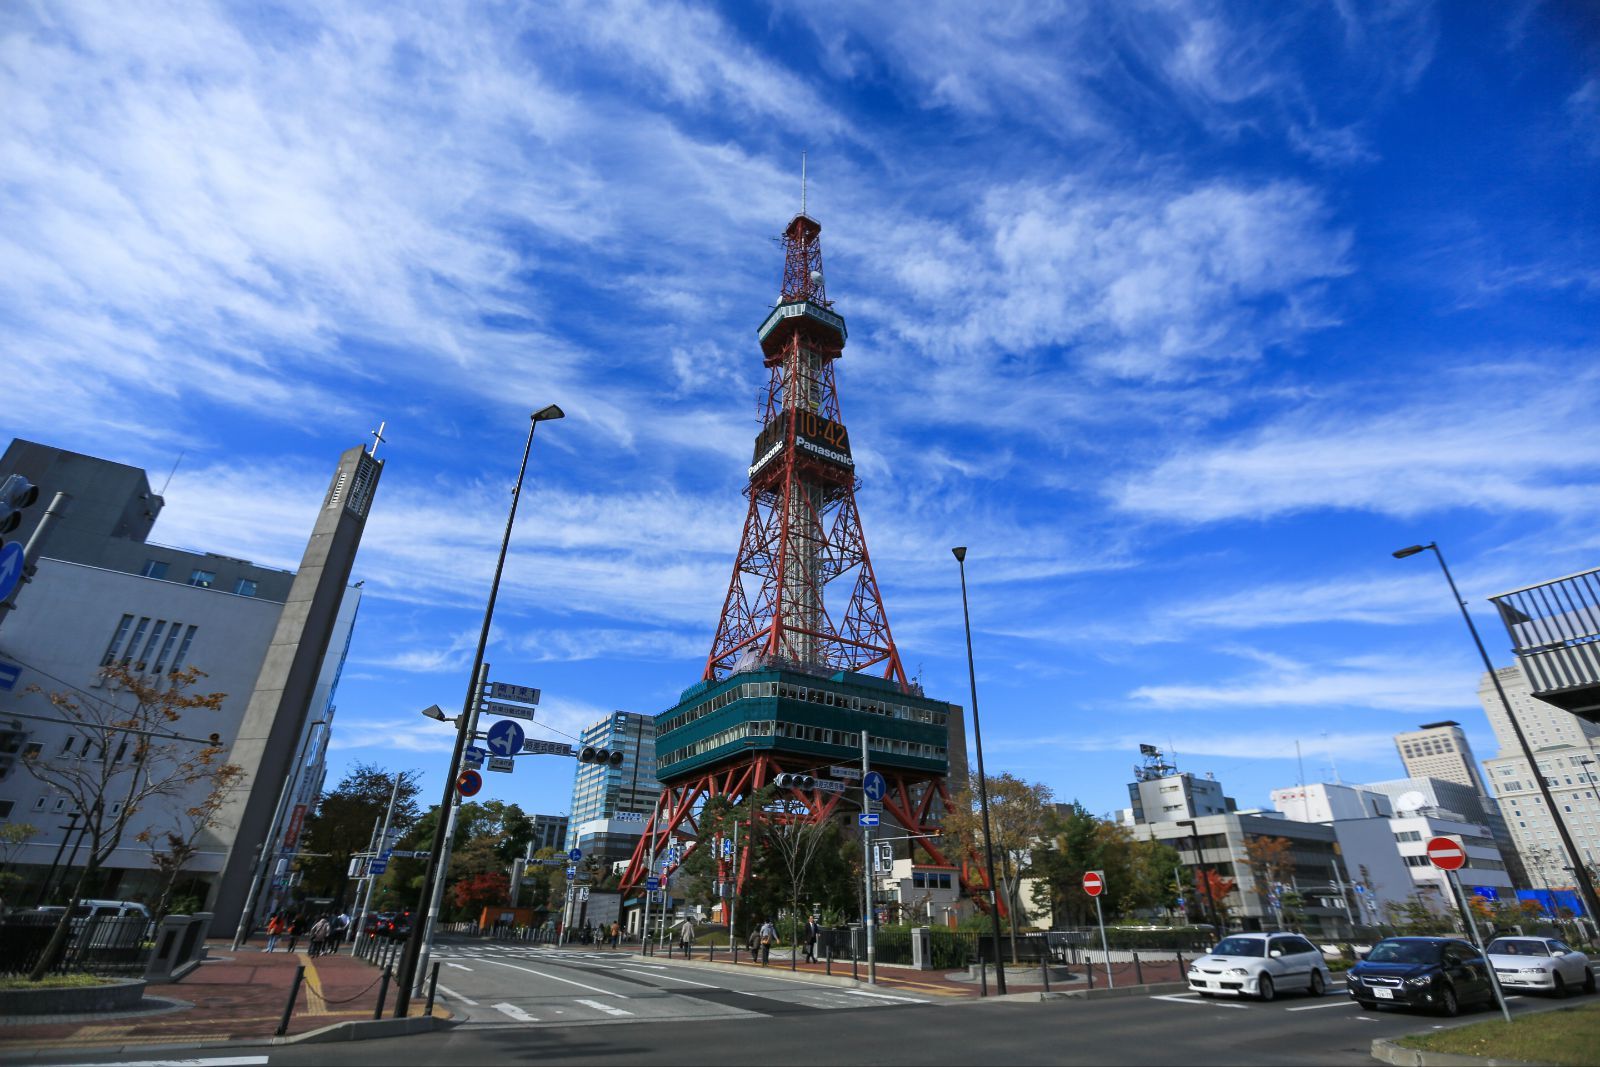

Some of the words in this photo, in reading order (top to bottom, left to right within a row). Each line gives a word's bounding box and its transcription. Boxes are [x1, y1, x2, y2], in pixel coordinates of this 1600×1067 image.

[800, 411, 846, 449] 10:42
[748, 440, 783, 477] Panasonic
[796, 435, 853, 465] Panasonic
